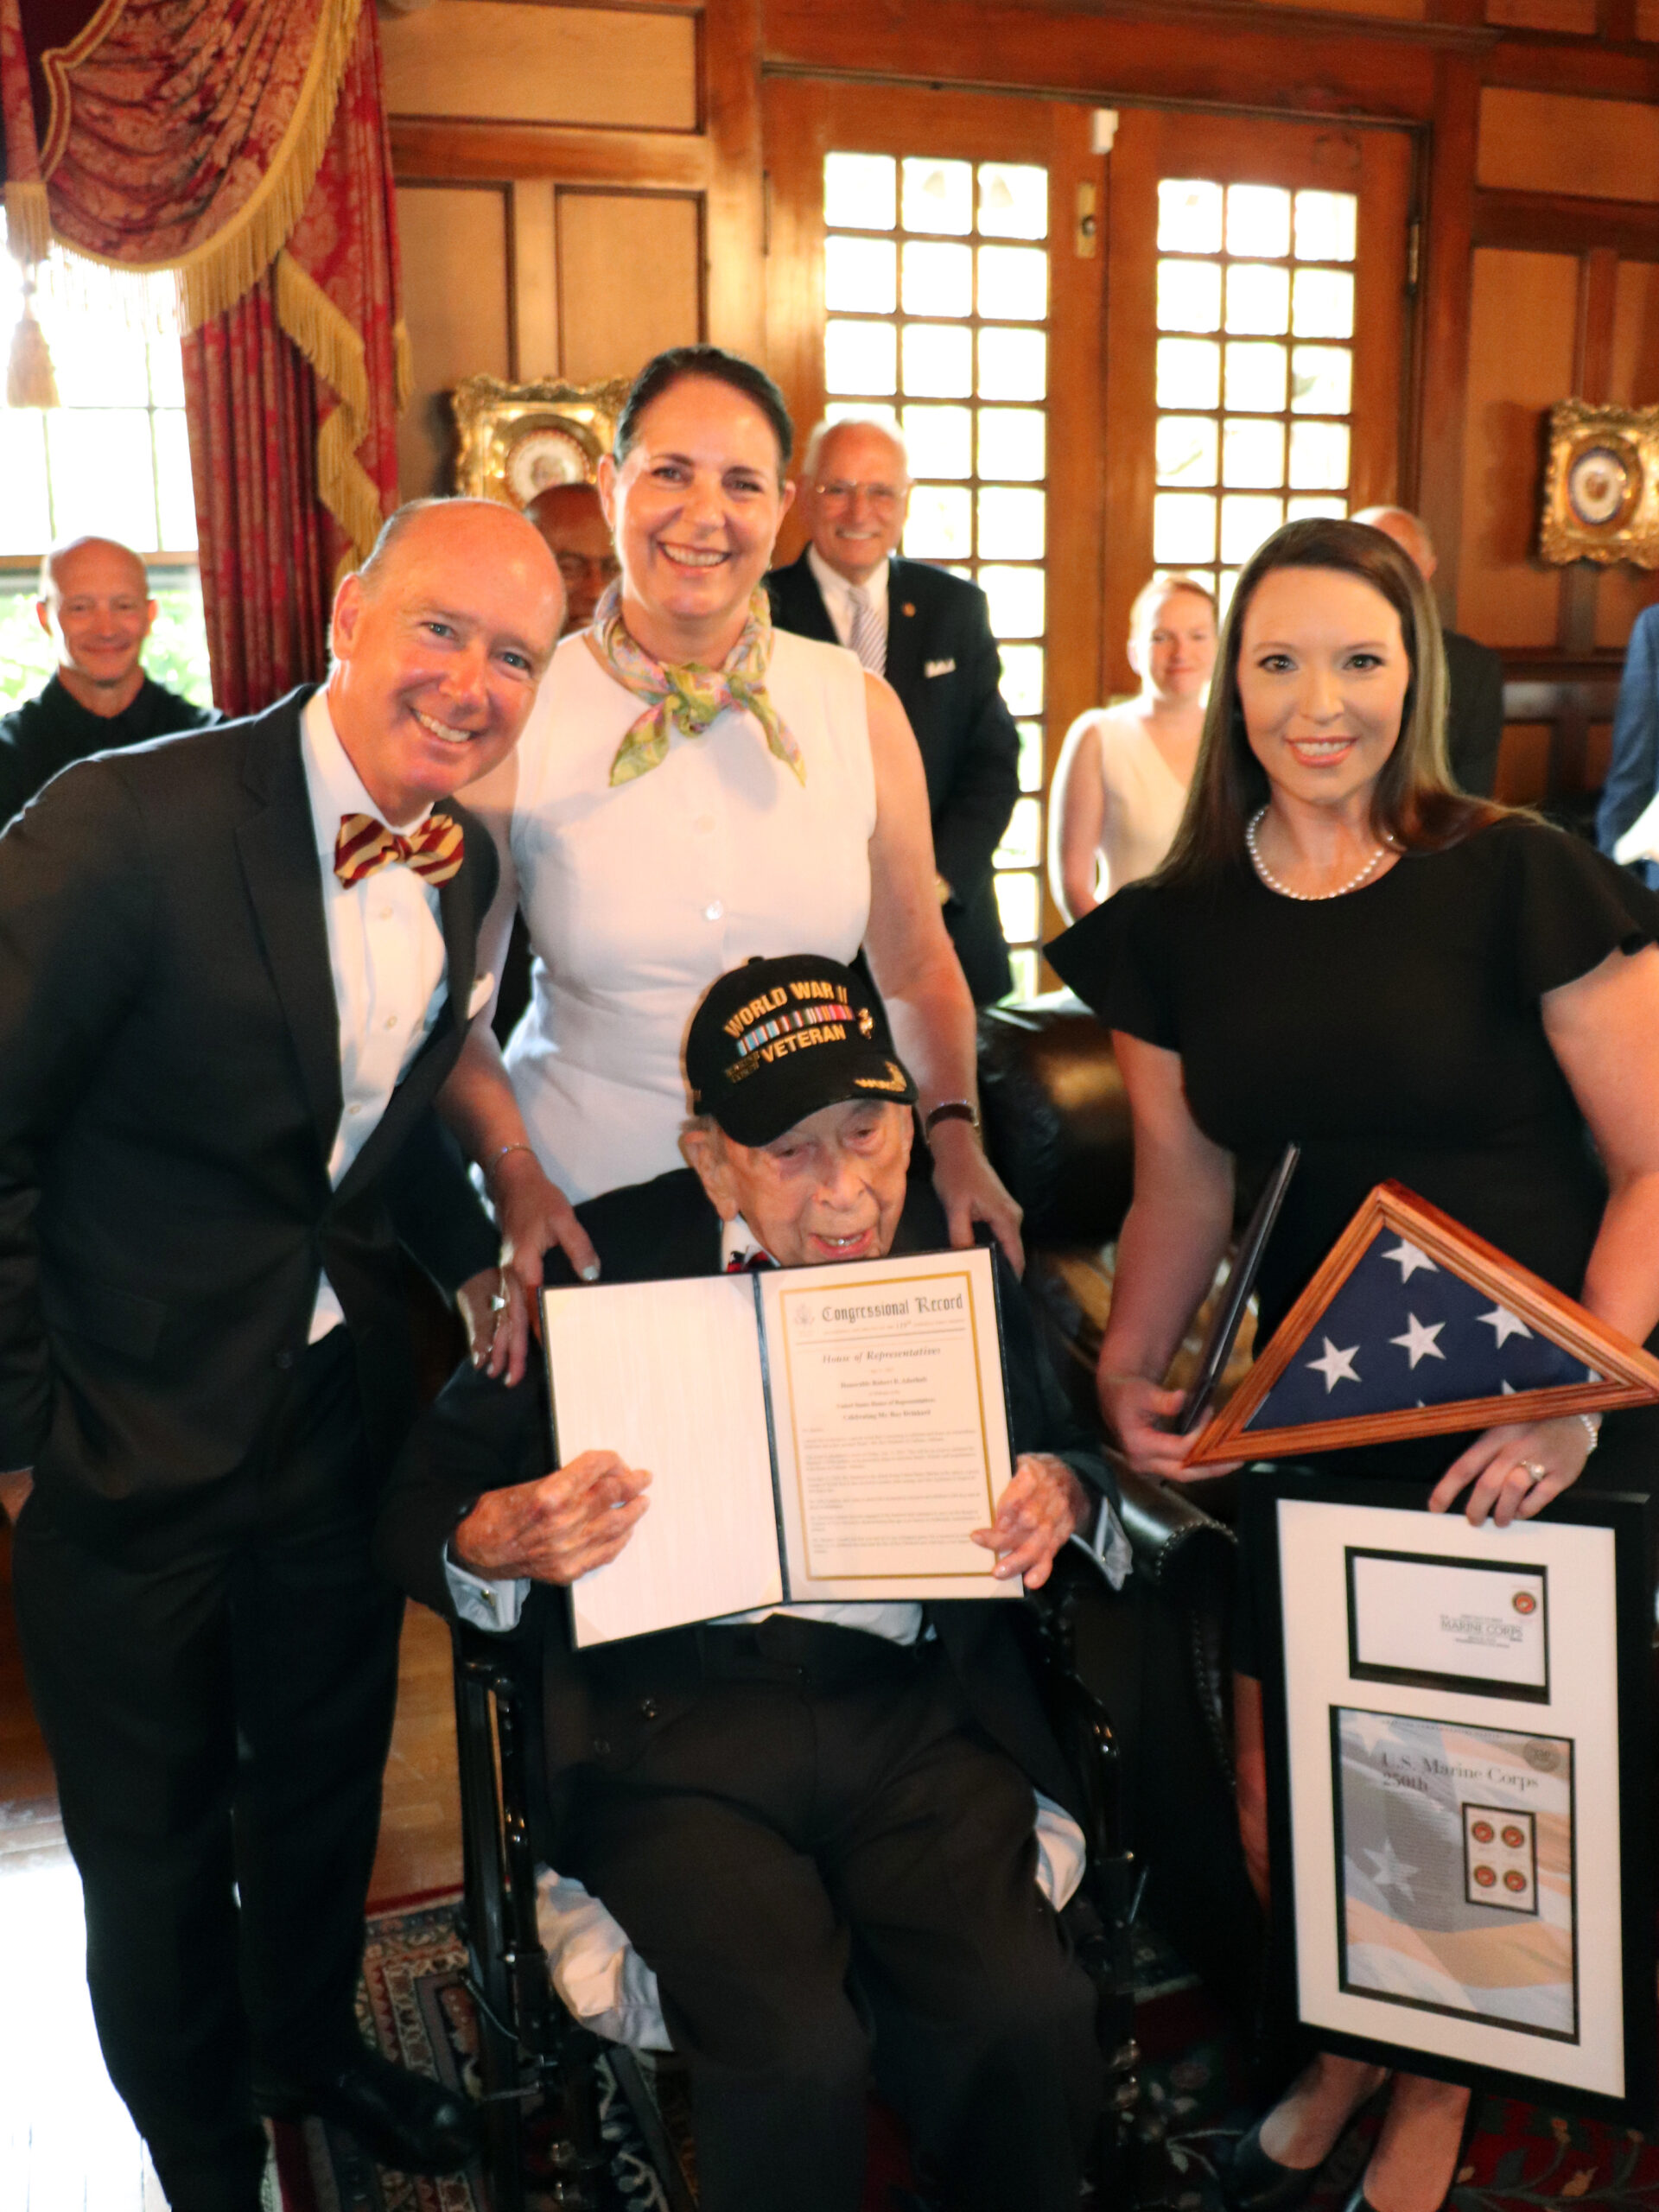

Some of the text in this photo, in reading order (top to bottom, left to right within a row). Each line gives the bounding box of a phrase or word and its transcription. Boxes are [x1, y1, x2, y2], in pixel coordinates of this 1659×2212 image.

[723, 980, 848, 1039] WORLD WAR II
[760, 1024, 847, 1063] VETERAN
[822, 1299, 910, 1324] Congressional
[914, 1294, 963, 1314] Record
[823, 1347, 941, 1363] House of Representatives
[1441, 1619, 1523, 1638] MARINE CORPS
[1382, 1751, 1539, 1791] U.S. Marine Corps
[1382, 1771, 1429, 1793] 250th
